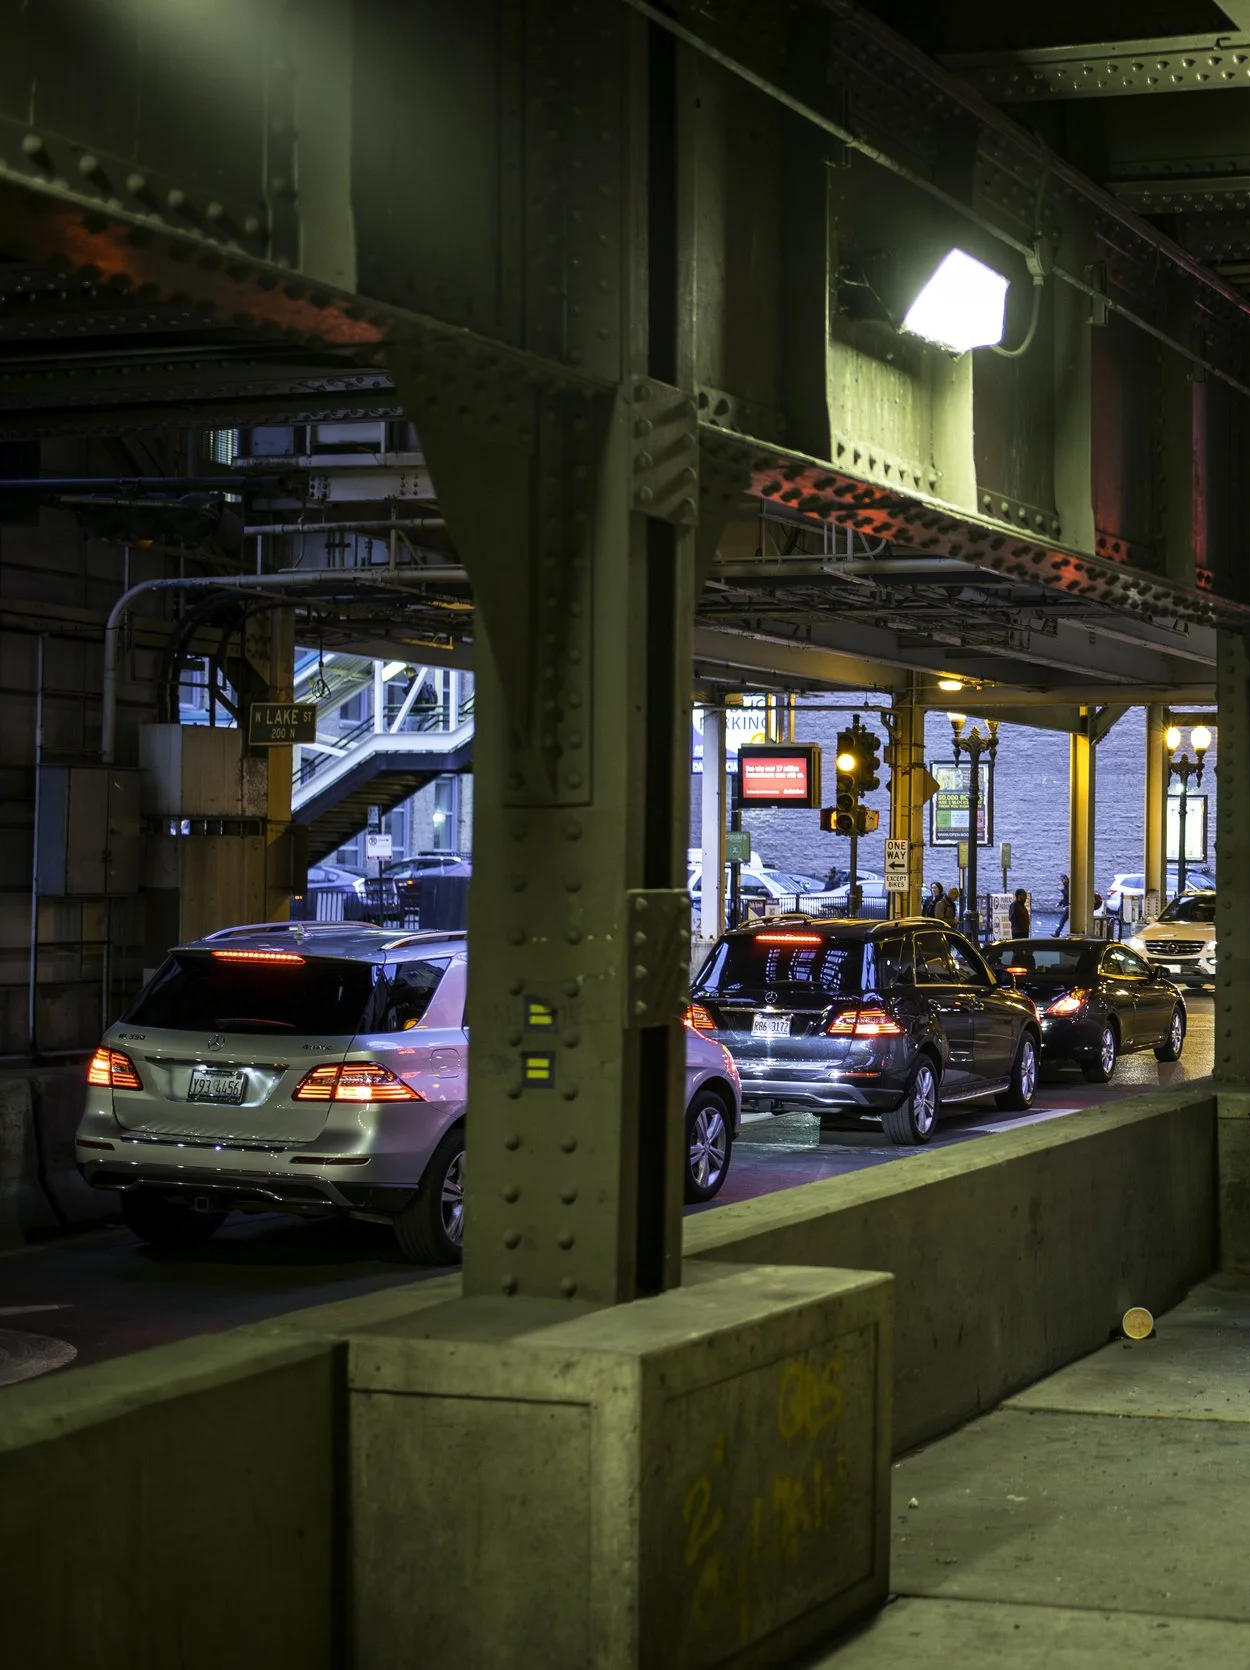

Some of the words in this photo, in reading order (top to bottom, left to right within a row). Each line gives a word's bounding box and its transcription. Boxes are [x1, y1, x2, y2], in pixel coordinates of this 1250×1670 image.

[266, 709, 299, 725] LAKE
[303, 711, 312, 722] ST
[271, 728, 287, 739] 200
[289, 728, 296, 739] N
[887, 841, 906, 850] ONE
[887, 851, 906, 860] WAY
[753, 1021, 768, 1031] R86
[772, 1021, 789, 1032] 3172
[193, 1078, 212, 1094] Y93
[215, 1080, 239, 1096] 4456
